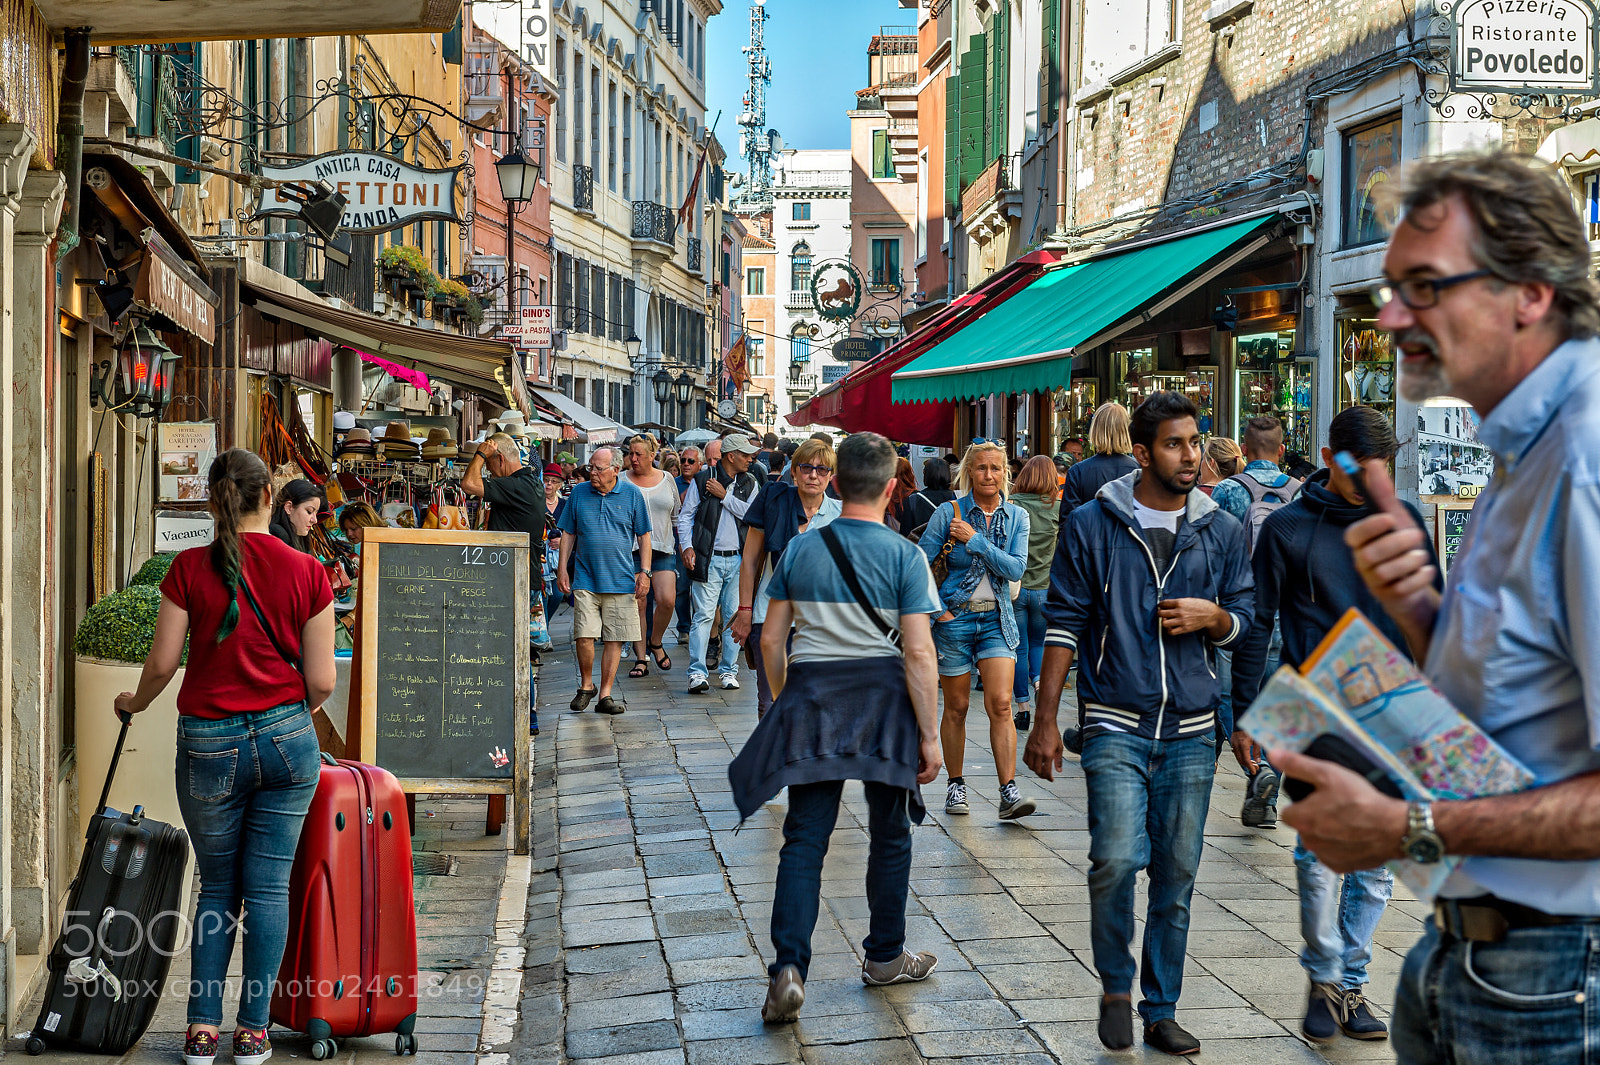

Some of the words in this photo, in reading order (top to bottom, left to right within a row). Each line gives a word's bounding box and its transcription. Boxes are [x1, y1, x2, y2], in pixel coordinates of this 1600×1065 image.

[1482, 0, 1567, 21] Pizzeria
[1472, 25, 1577, 42] Ristorante
[1466, 47, 1584, 74] Povoledo
[315, 156, 361, 180] ANTICA
[367, 158, 401, 182] CASA
[522, 308, 550, 318] GINO'S
[504, 326, 523, 334] PIZZA
[845, 341, 866, 350] HOTEL
[840, 350, 872, 358] PRINCIPE
[161, 528, 210, 542] Vacancy
[461, 545, 486, 565] 12
[489, 550, 509, 566] 00
[381, 564, 411, 577] MENU
[416, 565, 438, 578] DEL
[442, 566, 488, 580] GIORNO
